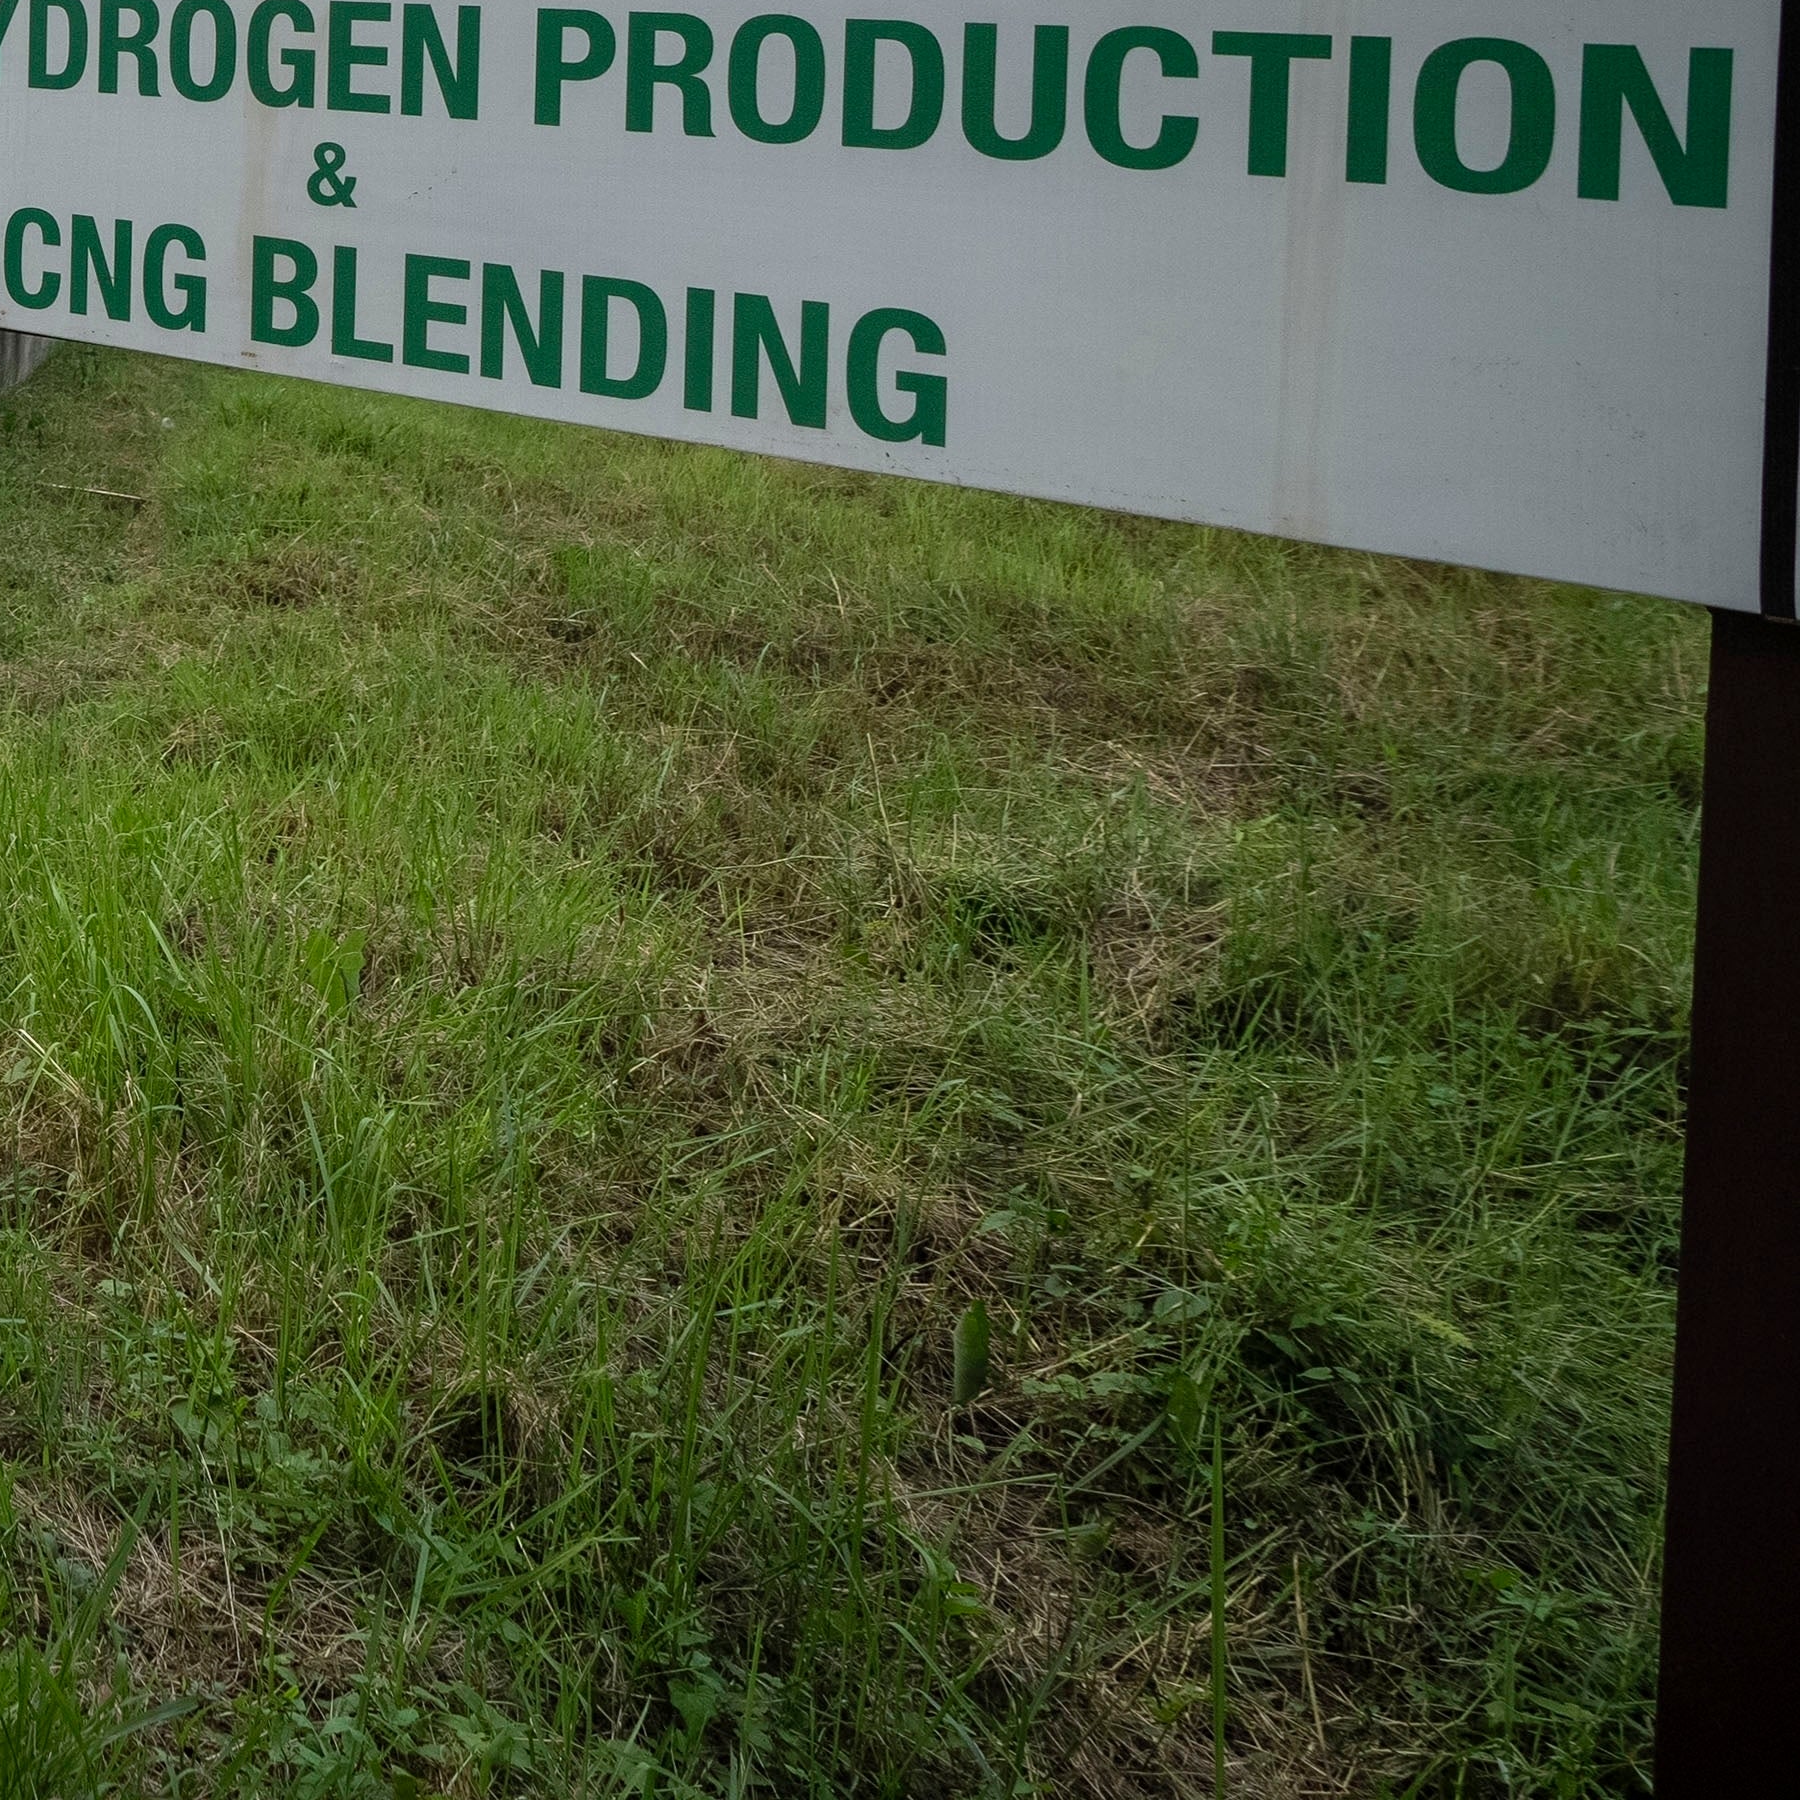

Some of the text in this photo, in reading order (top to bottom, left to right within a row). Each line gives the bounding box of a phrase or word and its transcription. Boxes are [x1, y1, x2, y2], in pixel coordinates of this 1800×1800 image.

[307, 141, 359, 208] &
[534, 7, 1736, 210] PRODUCTION
[250, 235, 950, 449] BLENDING
